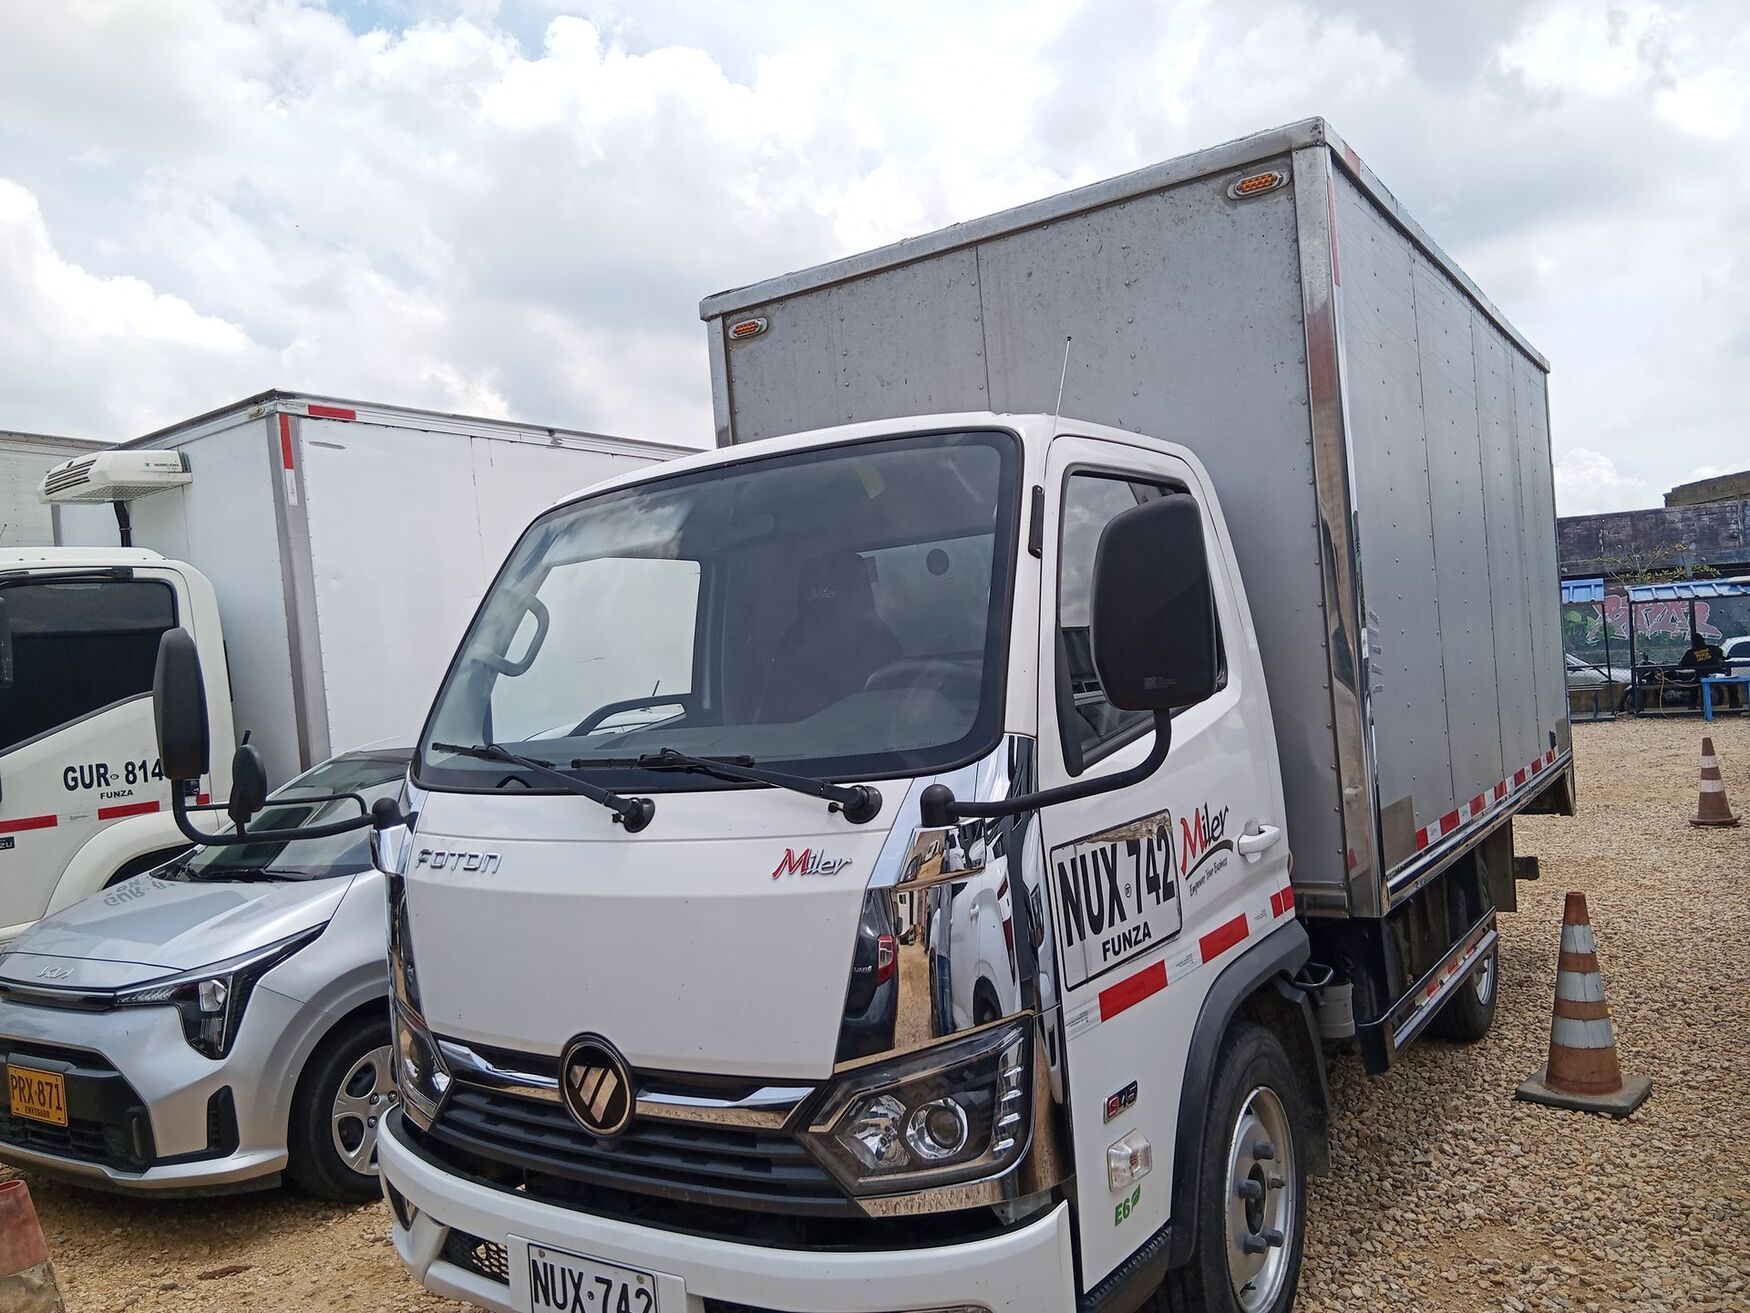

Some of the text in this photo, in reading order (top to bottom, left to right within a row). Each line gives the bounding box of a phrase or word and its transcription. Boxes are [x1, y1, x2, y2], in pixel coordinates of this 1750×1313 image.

[63, 758, 164, 791] GUR 814
[100, 789, 134, 800] FUNZA
[1180, 802, 1229, 876] Miler
[416, 849, 502, 874] FOTON
[772, 847, 853, 880] Miler
[1057, 825, 1176, 948] NUX 742
[1102, 921, 1152, 963] FUNZA
[10, 1074, 63, 1111] PRX 871
[1114, 1197, 1131, 1227] E6
[531, 1258, 587, 1313] NUX
